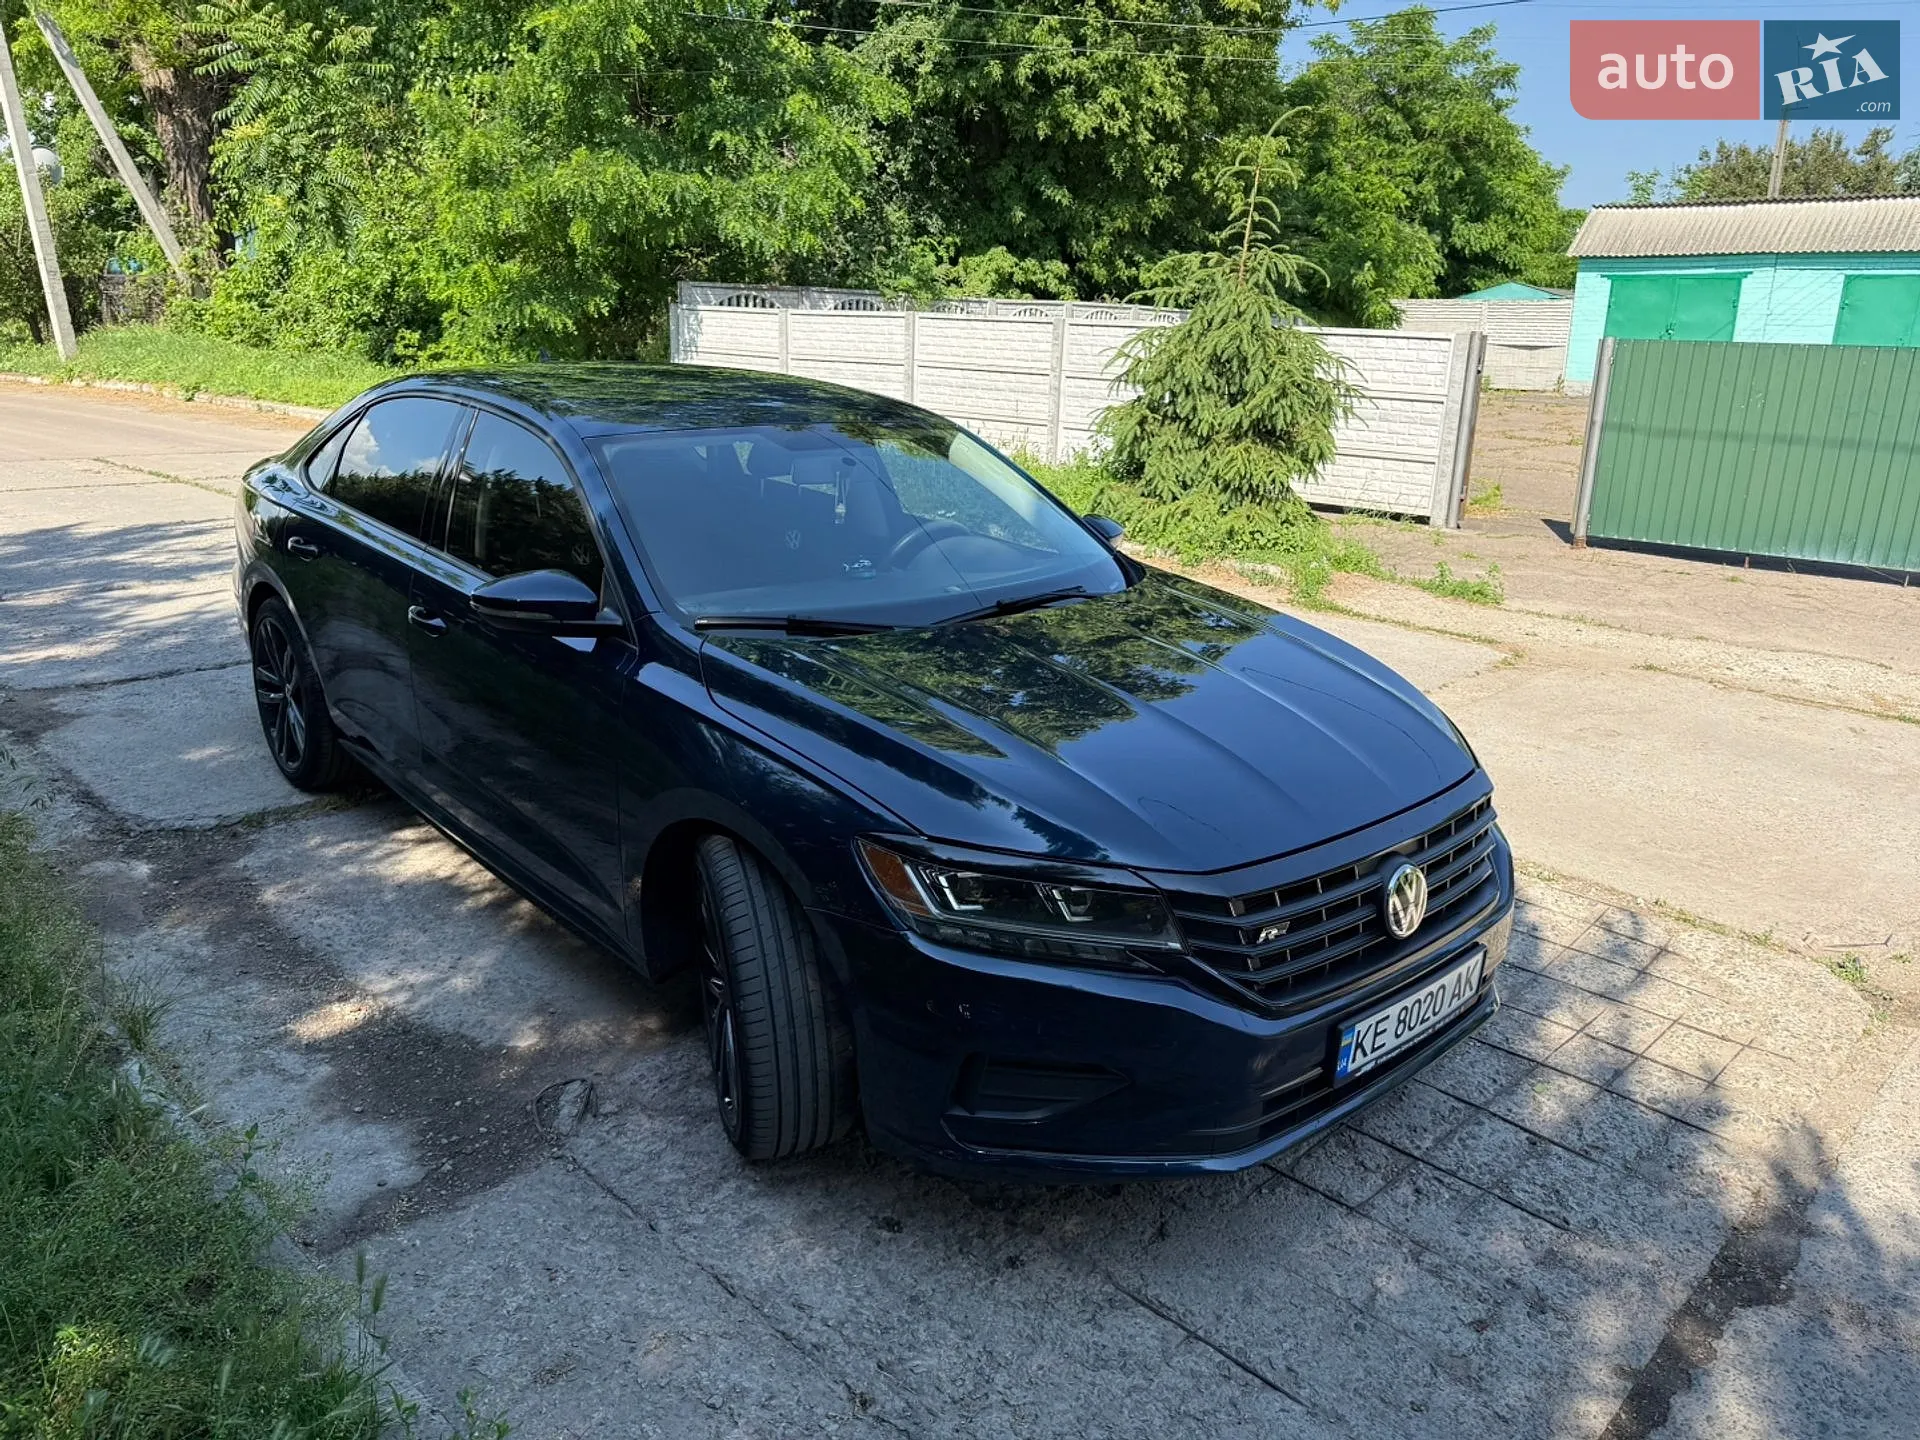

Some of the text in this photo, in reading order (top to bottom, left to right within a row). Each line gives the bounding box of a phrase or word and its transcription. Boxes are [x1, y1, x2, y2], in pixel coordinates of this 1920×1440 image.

[1352, 1014, 1390, 1064] KE
[1394, 983, 1446, 1039] 8020
[1448, 958, 1480, 1008] AK
